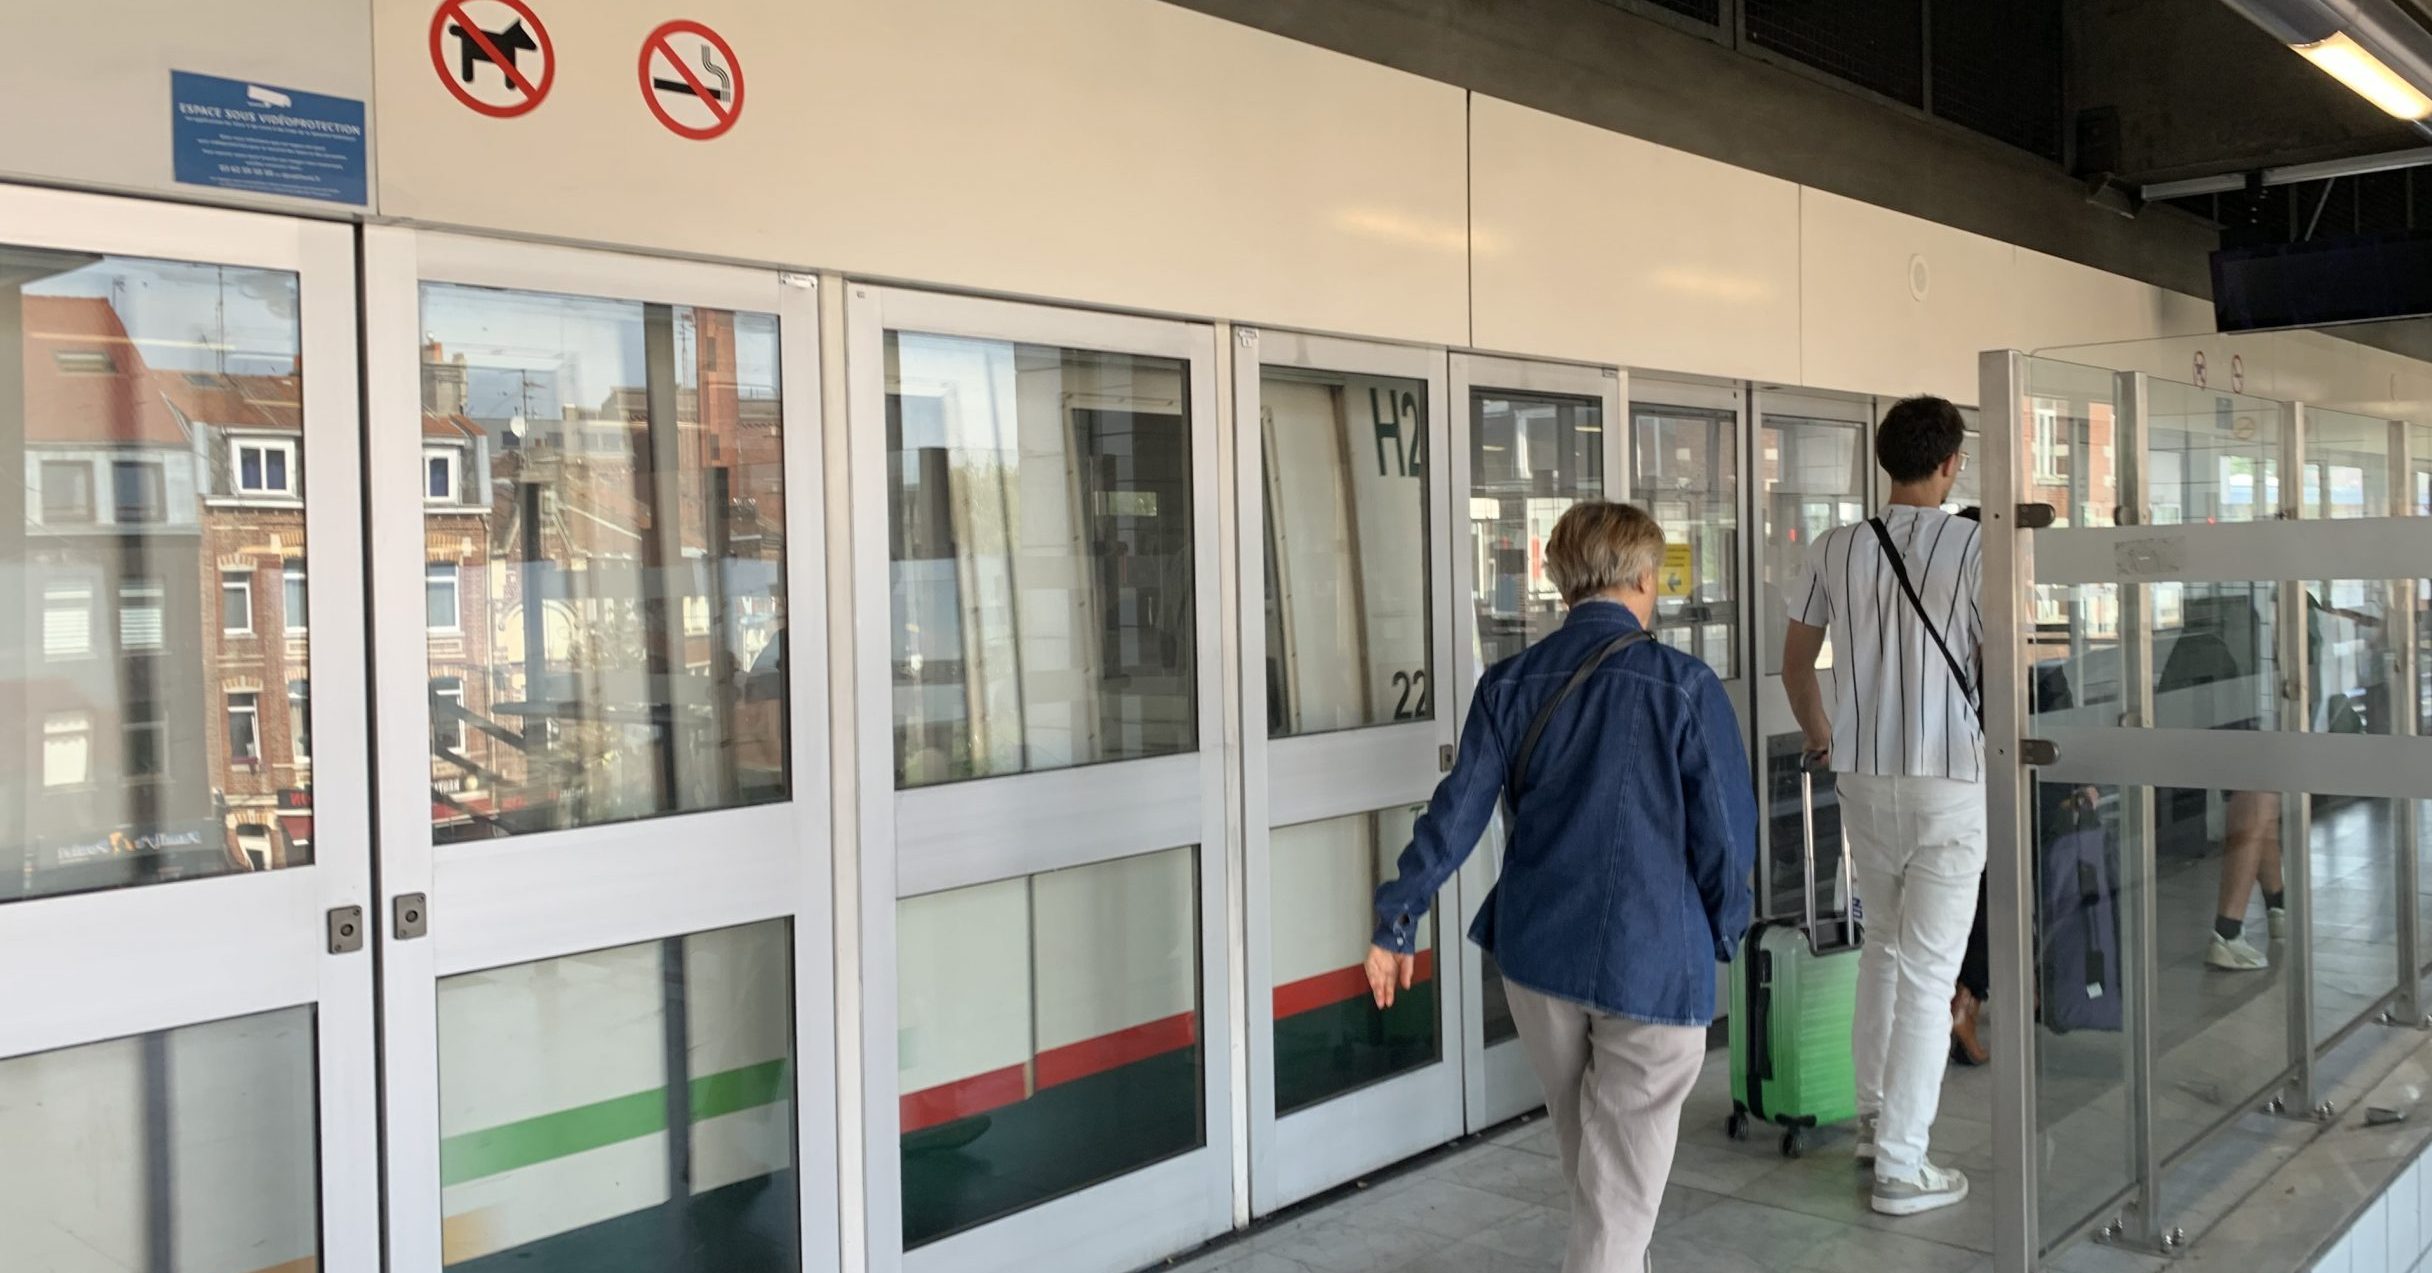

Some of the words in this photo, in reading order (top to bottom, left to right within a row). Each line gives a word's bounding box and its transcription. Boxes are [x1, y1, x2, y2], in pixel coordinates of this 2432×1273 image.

[179, 103, 222, 118] ESPACE
[225, 108, 256, 122] SOUS
[258, 112, 361, 136] VIDÉOPROTECTION
